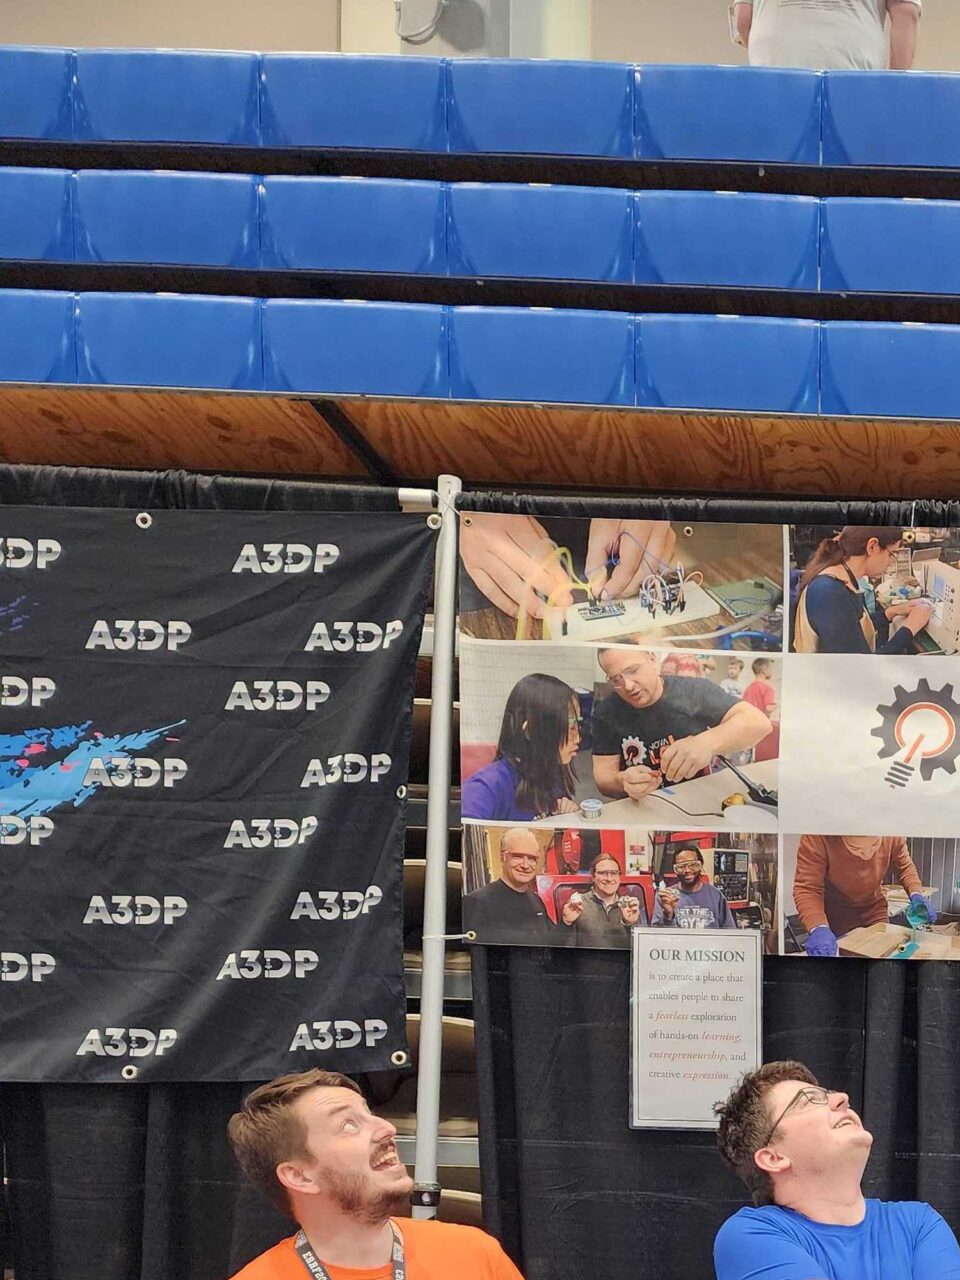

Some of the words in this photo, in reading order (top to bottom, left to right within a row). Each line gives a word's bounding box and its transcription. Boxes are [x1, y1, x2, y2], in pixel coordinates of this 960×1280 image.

[231, 542, 340, 574] A3DP
[85, 619, 193, 651] A3DP
[304, 619, 403, 653] A3DP
[224, 680, 330, 711] A3DP
[81, 756, 188, 788] A3DP
[300, 752, 392, 788] A3DP
[223, 815, 318, 849] A3DP
[83, 894, 188, 925] A3DP
[290, 885, 383, 920] A3DP
[216, 949, 319, 981] A3DP
[649, 949, 681, 961] OUR
[685, 950, 745, 962] MISSION
[657, 973, 666, 981] to
[669, 973, 693, 981] create
[702, 973, 724, 984] place
[726, 973, 744, 983] that
[649, 991, 678, 1001] enables
[681, 992, 708, 1003] people
[711, 994, 719, 1002] to
[722, 992, 744, 1003] share
[655, 1010, 689, 1022] fearless
[690, 1011, 737, 1023] exploration
[76, 1027, 178, 1057] A3DP
[288, 1018, 388, 1053] A3DP
[649, 1029, 659, 1040] of
[659, 1030, 699, 1041] hands-on
[701, 1031, 742, 1044] learning,
[649, 1050, 728, 1062] entrepreneurship,
[730, 1051, 746, 1061] and
[649, 1070, 680, 1079] creative
[683, 1072, 731, 1081] expression.
